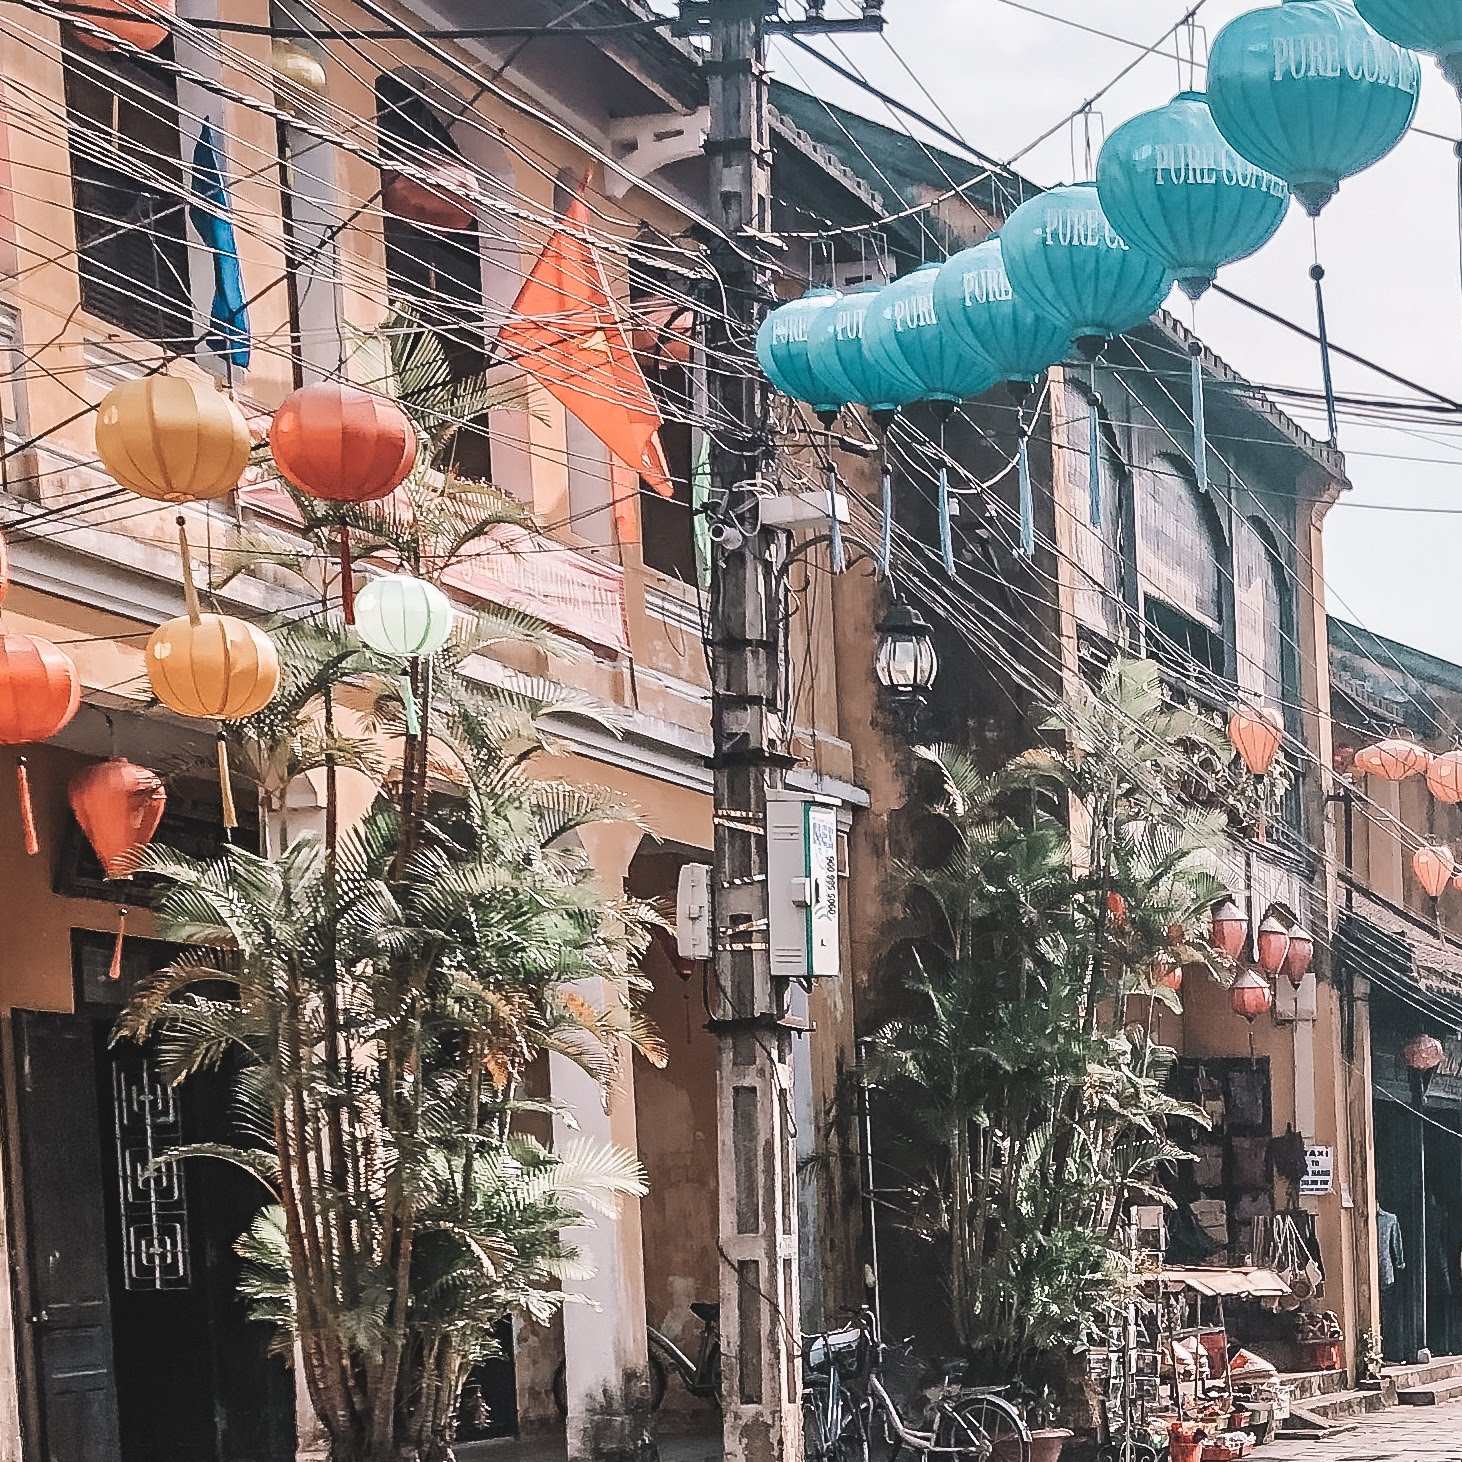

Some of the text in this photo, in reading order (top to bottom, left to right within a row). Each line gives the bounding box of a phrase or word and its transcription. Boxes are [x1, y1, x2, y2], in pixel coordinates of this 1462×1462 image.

[1273, 35, 1418, 95] PURE COFFE
[1155, 143, 1216, 185] PURE
[1045, 209, 1099, 246] PURE
